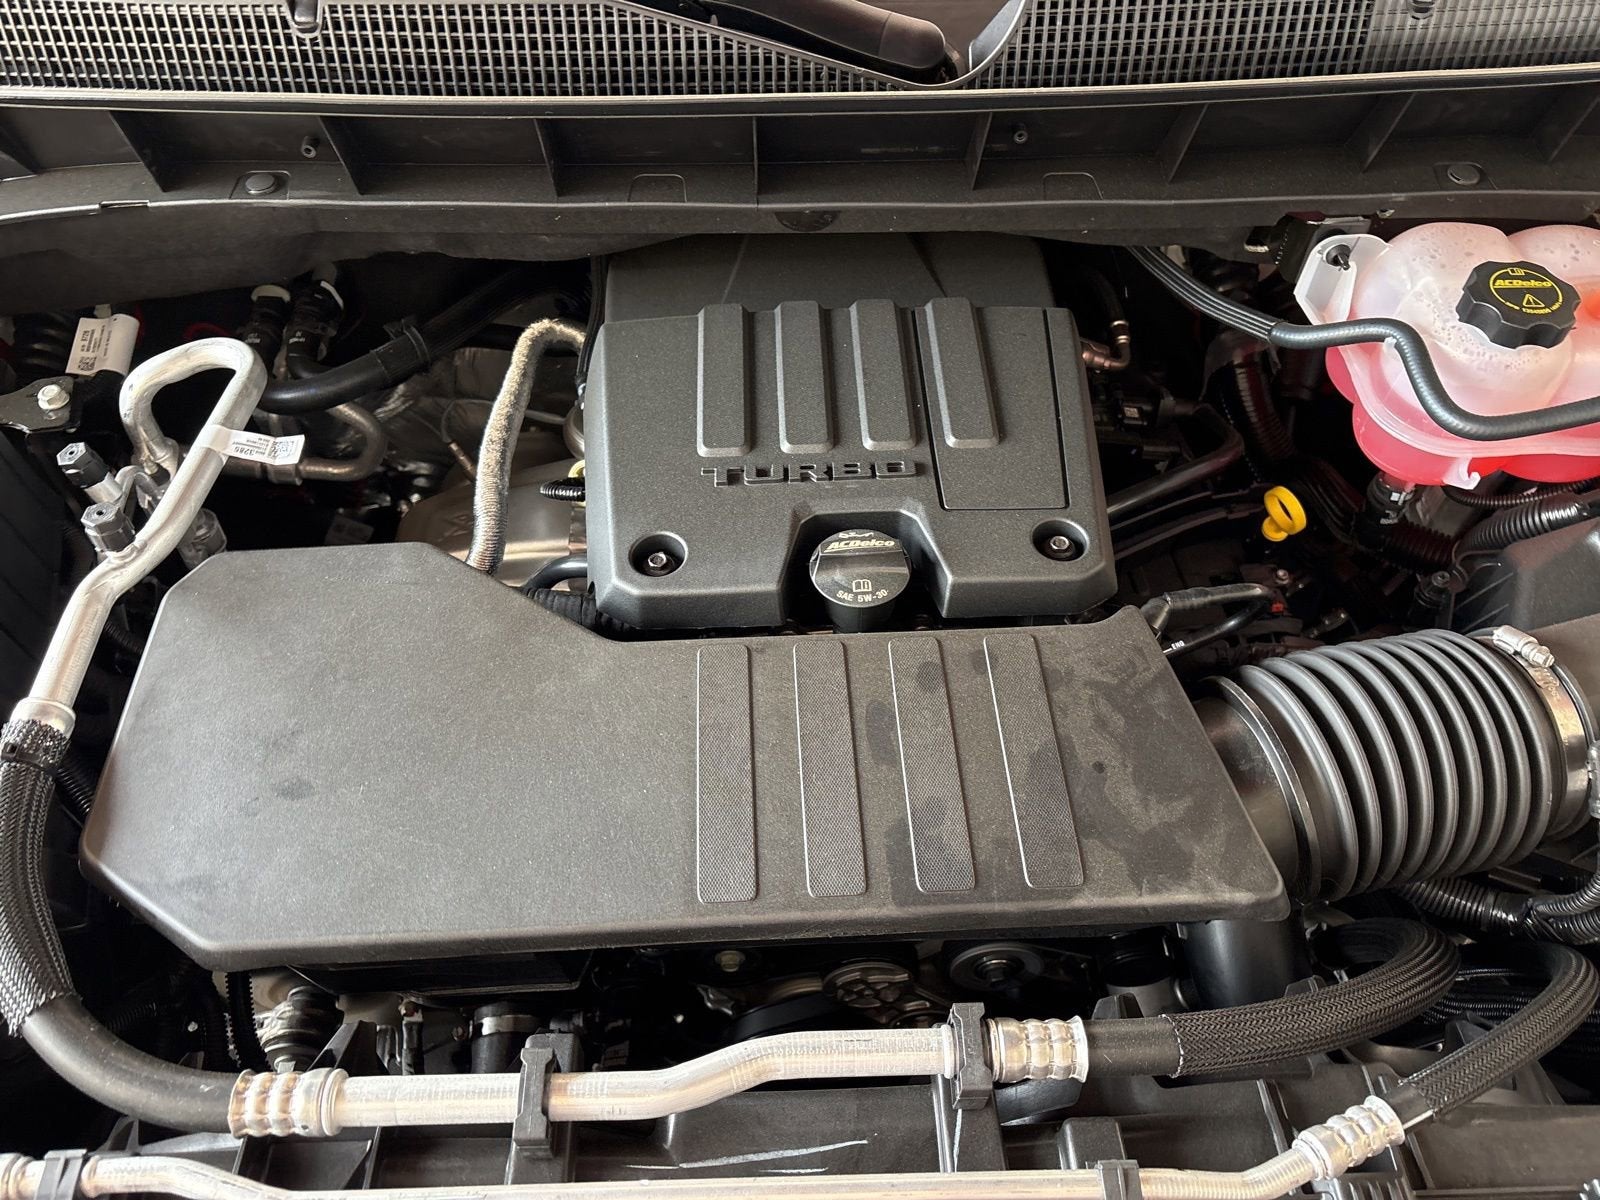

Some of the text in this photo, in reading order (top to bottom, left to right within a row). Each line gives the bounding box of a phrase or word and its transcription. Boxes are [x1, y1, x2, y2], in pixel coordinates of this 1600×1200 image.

[1494, 279, 1552, 288] ACDelco
[701, 461, 918, 487] TURBO
[826, 539, 895, 551] ACDelco
[836, 589, 888, 602] SAE 5W-30
